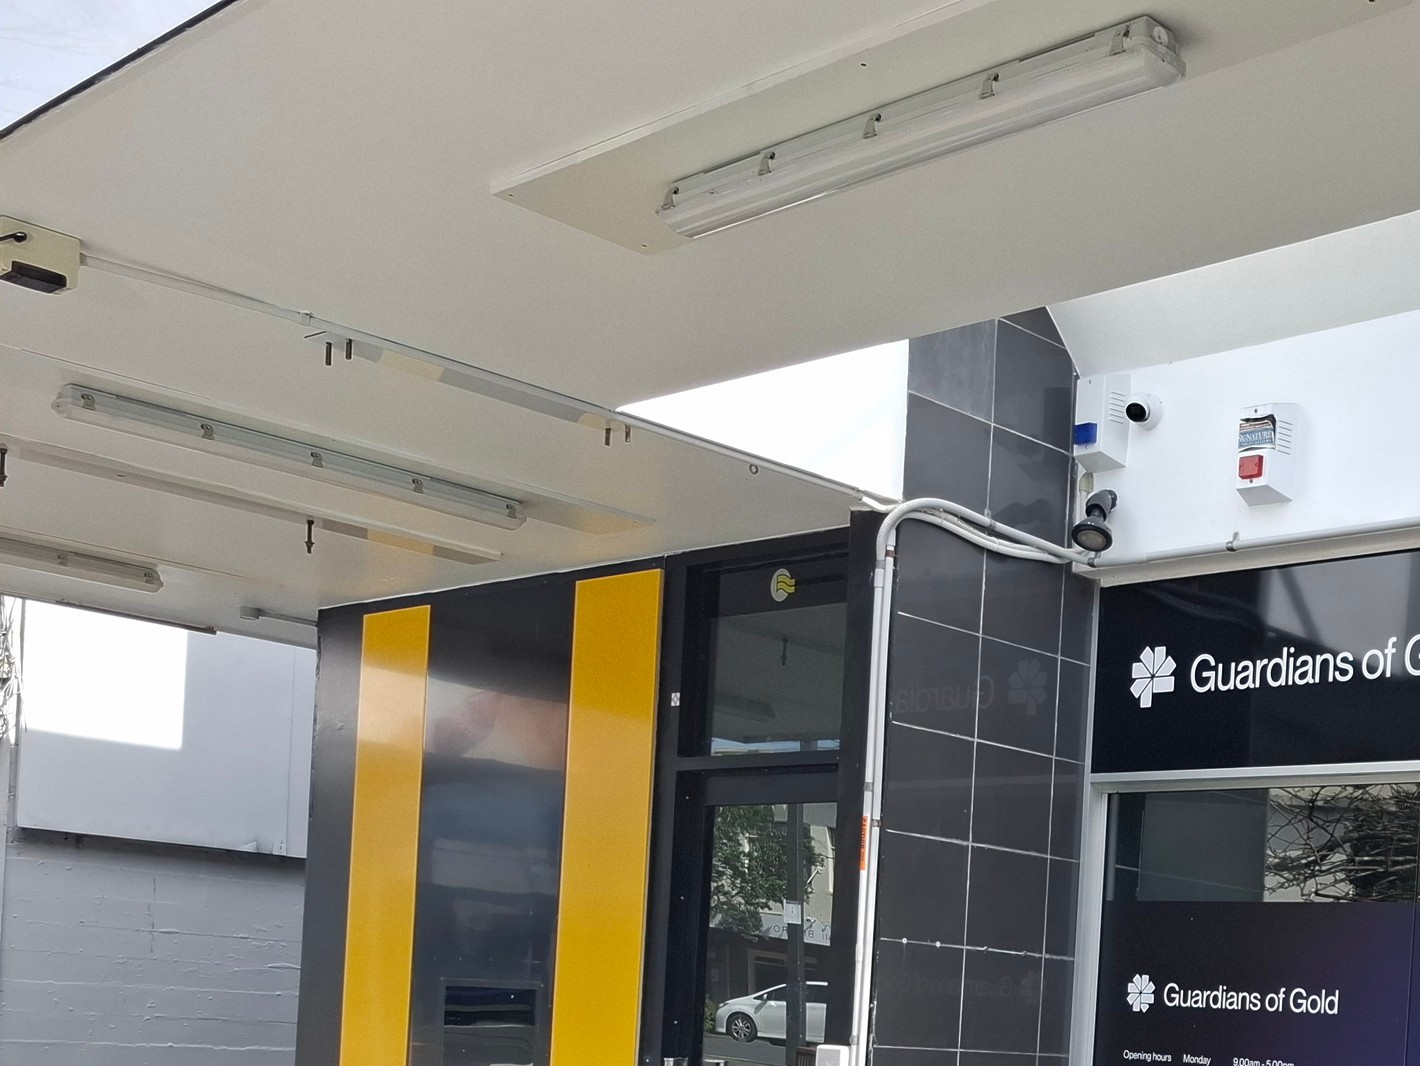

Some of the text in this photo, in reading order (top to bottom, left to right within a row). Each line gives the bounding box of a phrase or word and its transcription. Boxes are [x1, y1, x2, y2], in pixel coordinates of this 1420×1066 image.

[1191, 648, 1352, 692] Guardians
[1362, 637, 1397, 679] of
[1164, 983, 1339, 1014] Guardians of Gold
[1123, 1050, 1171, 1062] Opening hours
[1183, 1054, 1211, 1066] Monday
